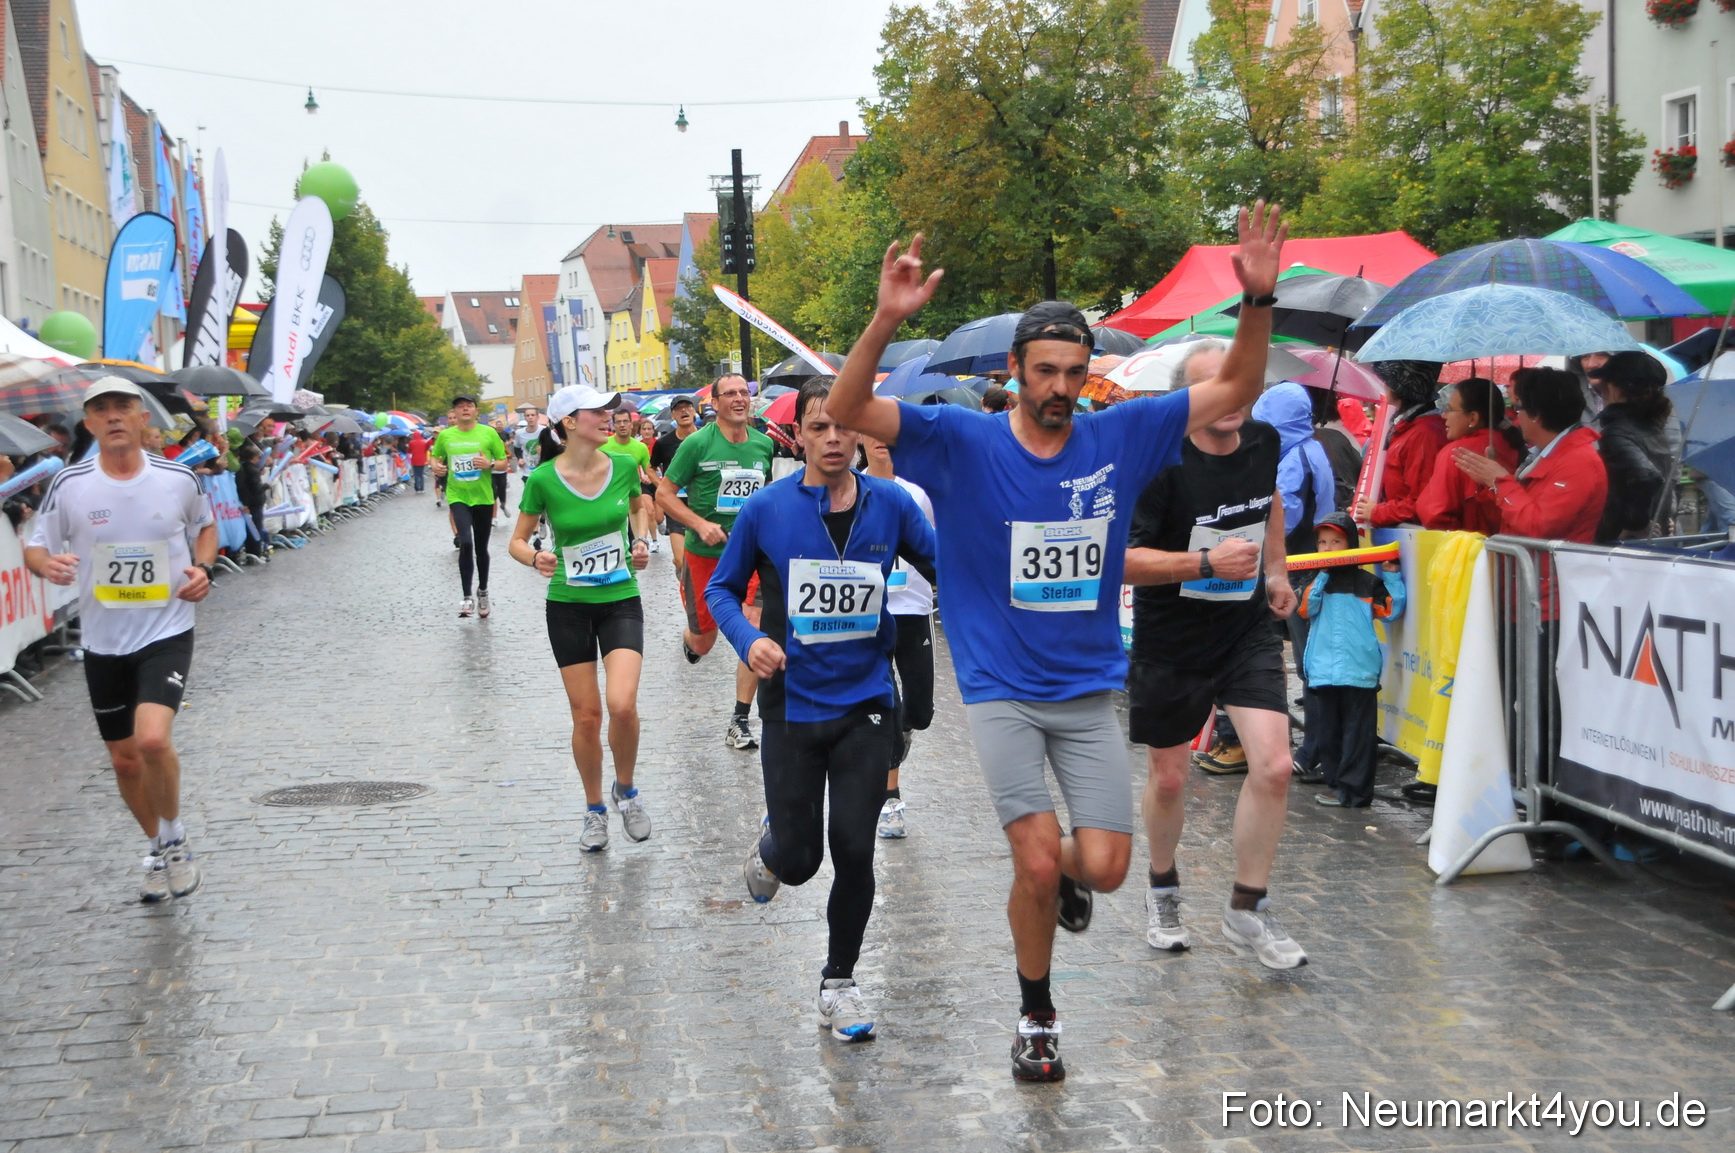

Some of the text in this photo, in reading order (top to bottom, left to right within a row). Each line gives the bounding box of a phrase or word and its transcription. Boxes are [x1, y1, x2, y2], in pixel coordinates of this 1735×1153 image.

[126, 248, 163, 272] maxi
[314, 311, 330, 334] SWEDEN
[282, 287, 306, 379] Audi BKK
[723, 480, 760, 497] 2336
[1044, 526, 1083, 538] BOCK
[580, 540, 605, 553] BOCK
[572, 548, 621, 576] 2277
[819, 566, 856, 575] BOCK
[1022, 543, 1101, 580] 3319
[108, 560, 155, 584] 278
[119, 590, 147, 600] Heinz
[1042, 586, 1082, 600] Stefan
[1205, 581, 1244, 592] Johann
[799, 583, 876, 614] 2987
[812, 620, 856, 632] Bastian
[1581, 726, 1657, 761] INTERNETLÖSUNGEN
